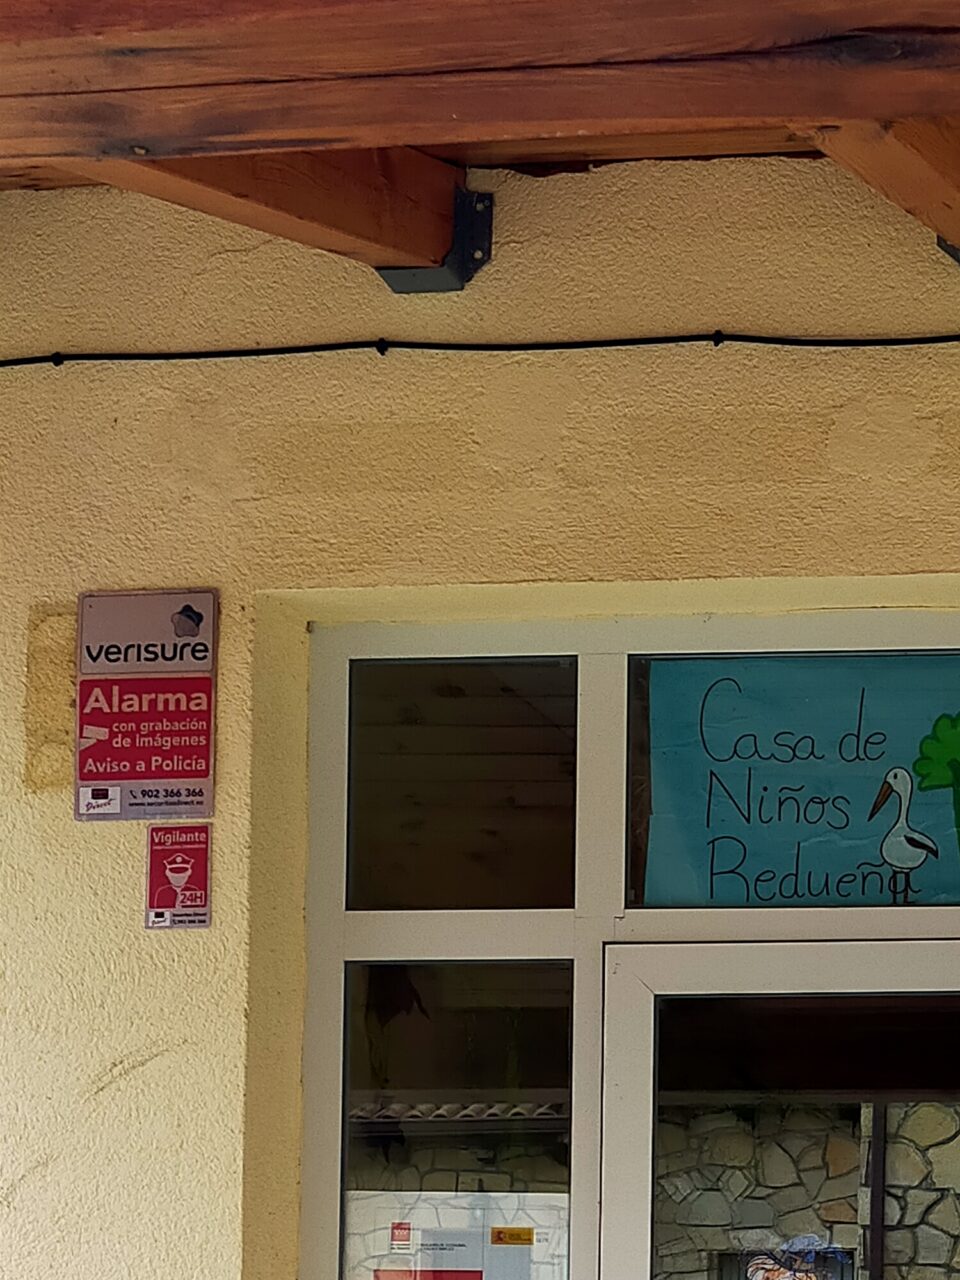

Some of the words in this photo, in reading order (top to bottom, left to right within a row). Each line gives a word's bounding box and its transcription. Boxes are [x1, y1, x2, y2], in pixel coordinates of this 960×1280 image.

[85, 642, 209, 663] verisure
[83, 685, 208, 714] Alarma
[112, 722, 136, 732] con
[140, 718, 207, 735] grabación
[700, 677, 825, 763] Casa
[838, 687, 887, 763] de
[112, 734, 132, 748] de
[83, 757, 130, 774] Aviso
[135, 761, 146, 772] a
[151, 755, 206, 771] Policía
[140, 789, 160, 799] 902
[163, 788, 182, 799] 366
[185, 787, 204, 798] 366
[706, 766, 851, 830] Niños
[152, 831, 206, 846] Vigilante
[707, 835, 922, 902] Redueña
[180, 892, 203, 904] 24H
